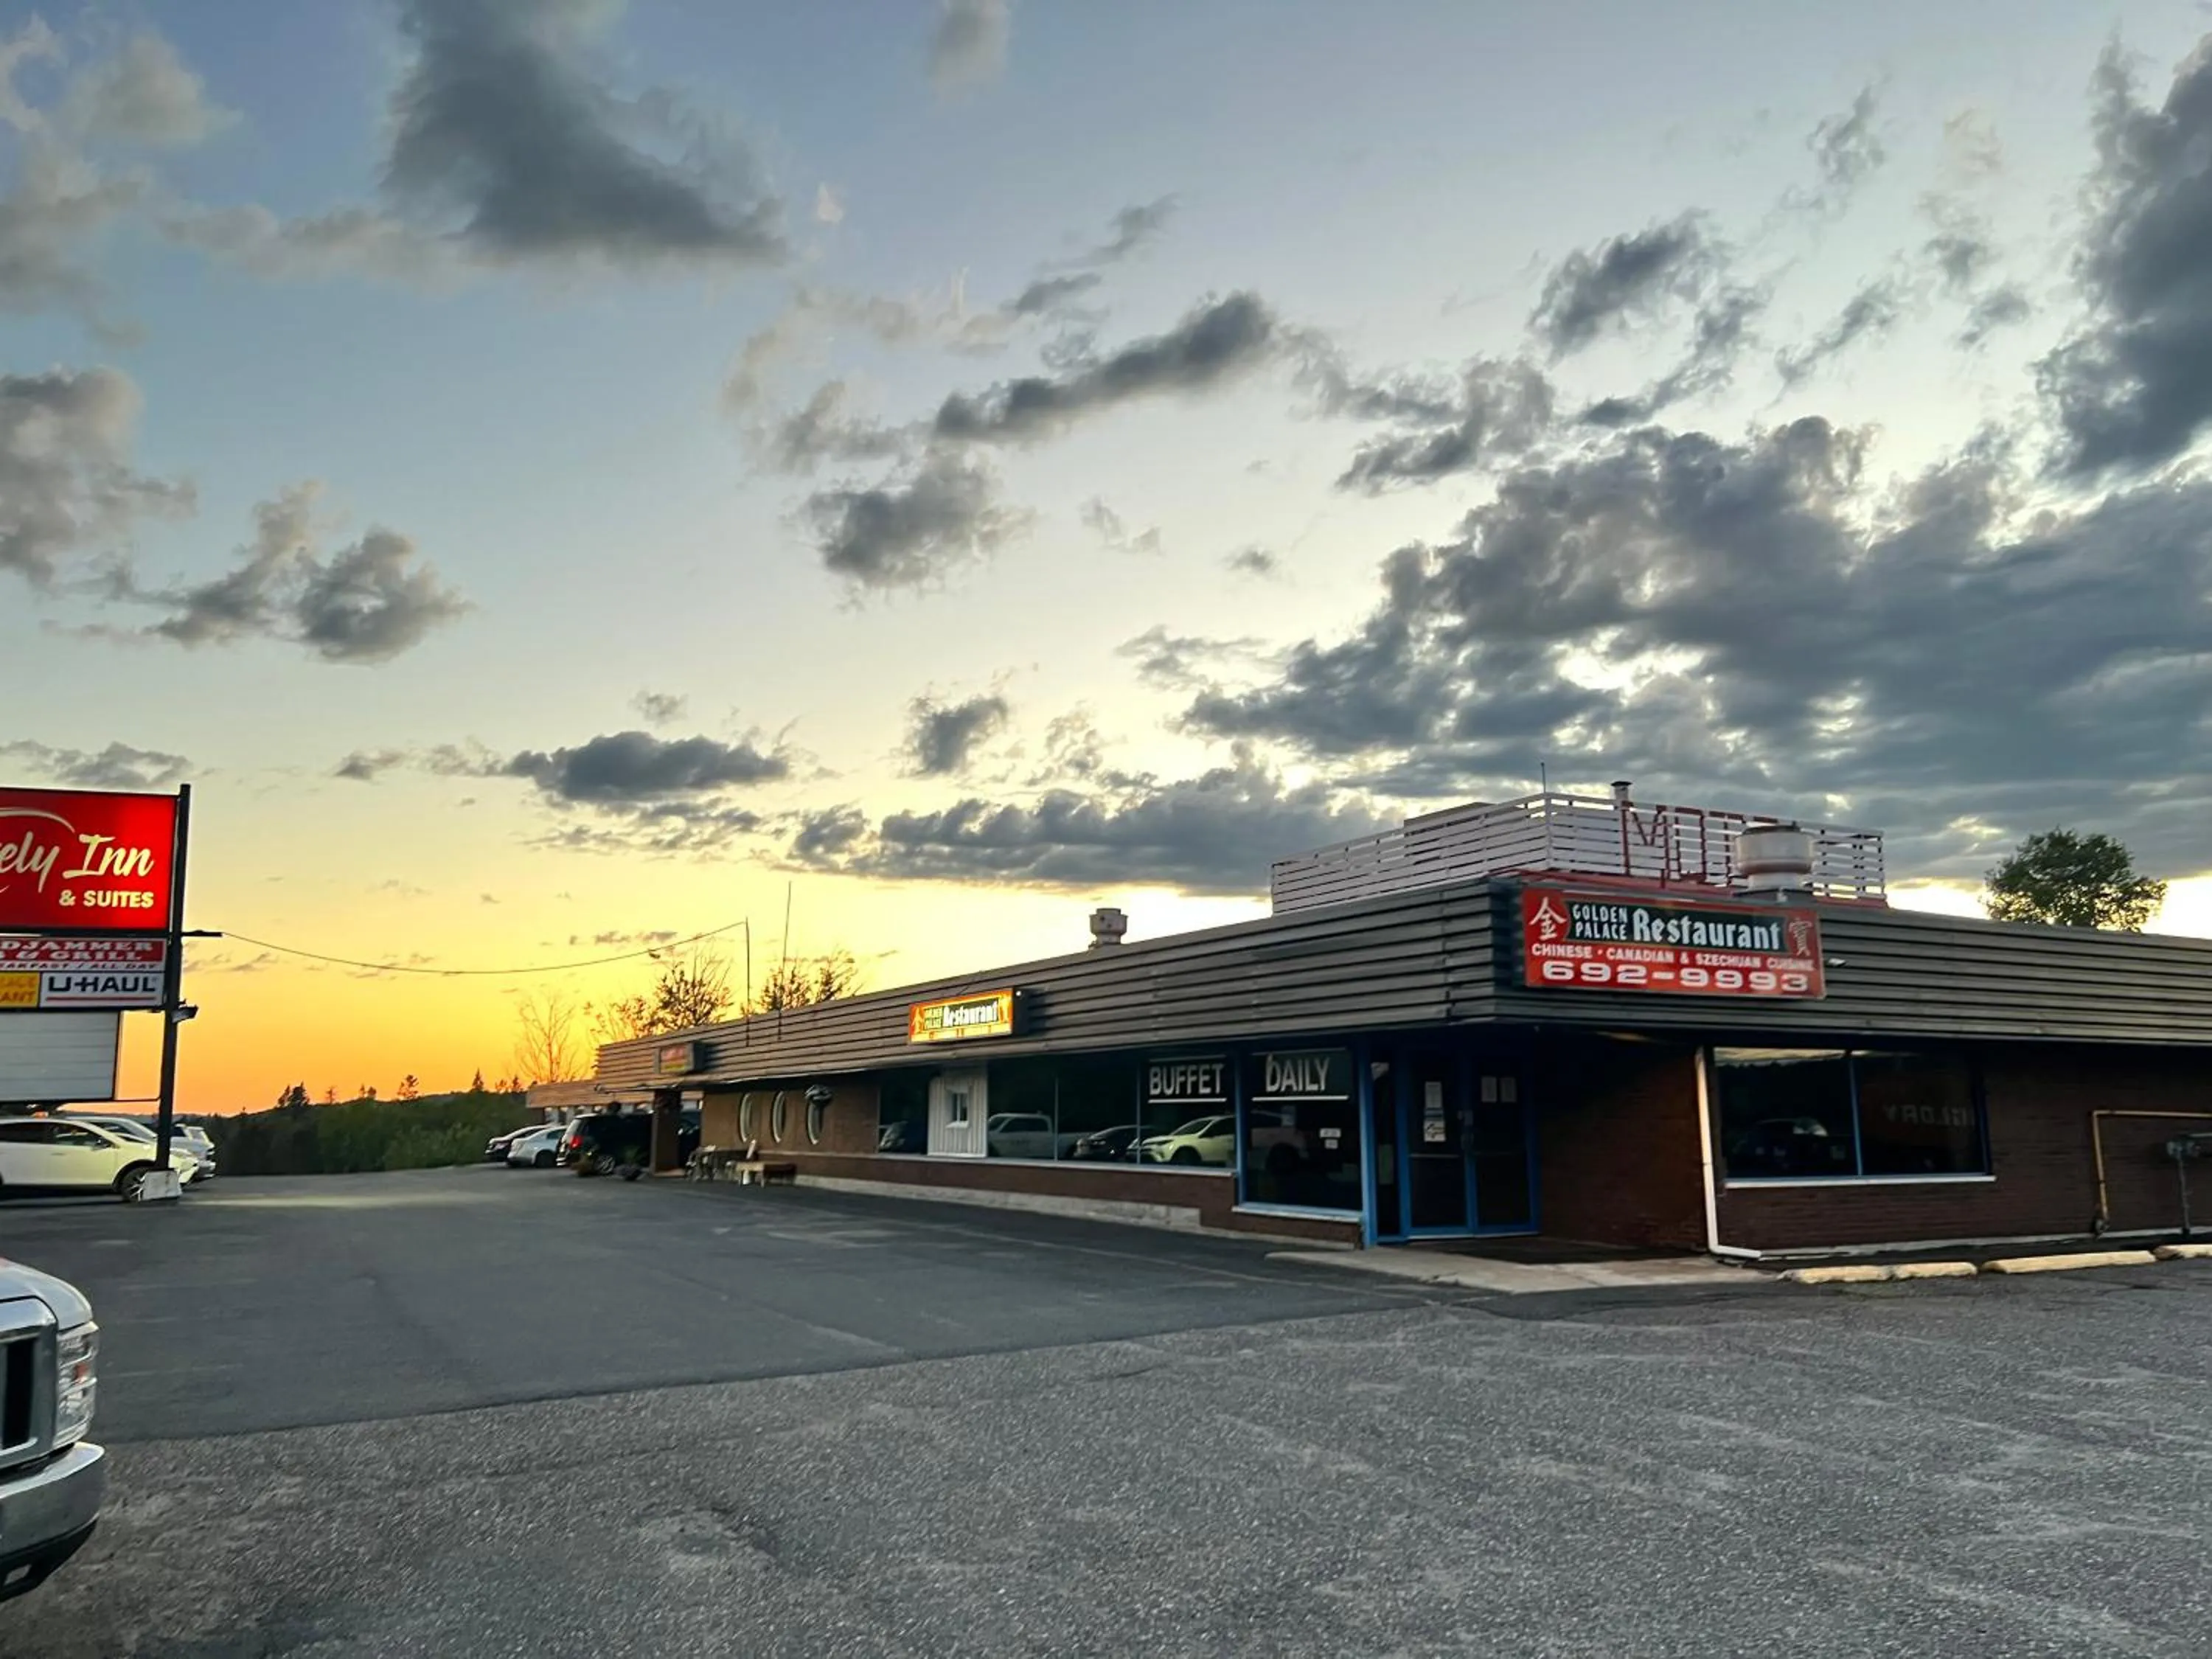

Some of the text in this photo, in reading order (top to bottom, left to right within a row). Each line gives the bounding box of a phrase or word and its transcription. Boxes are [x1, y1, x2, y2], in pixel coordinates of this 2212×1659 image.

[0, 831, 155, 893] ely Inn
[59, 889, 154, 908] & SUITES
[1572, 904, 1628, 923] GOLDEN
[1529, 897, 1567, 941] 金
[1575, 921, 1628, 940] PALACE
[1632, 908, 1781, 950] Restaurant
[1531, 943, 1593, 959] CHINESE
[1606, 947, 1674, 963] CANADIAN
[1680, 952, 1690, 964] &
[49, 976, 156, 992] U-HAUL
[1542, 960, 1809, 992] 692-9993
[1150, 1063, 1225, 1096] BUFFET
[1265, 1053, 1330, 1093] DAILY
